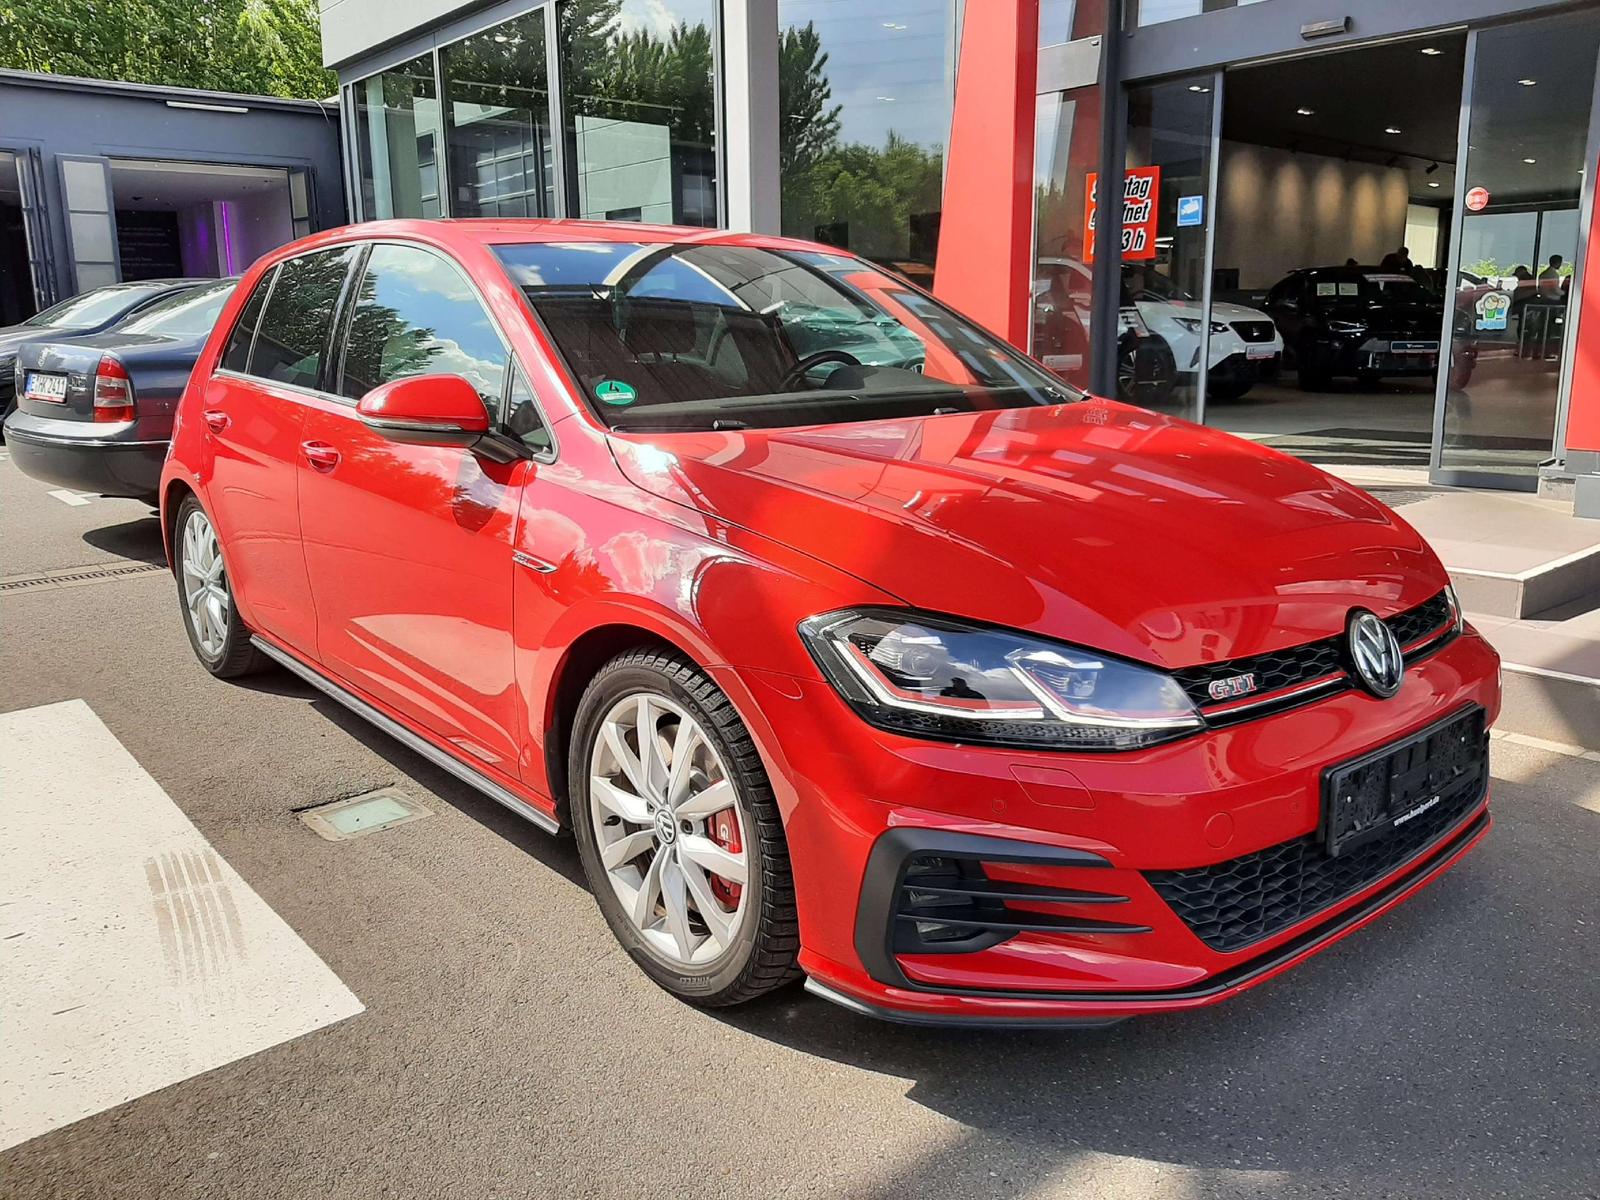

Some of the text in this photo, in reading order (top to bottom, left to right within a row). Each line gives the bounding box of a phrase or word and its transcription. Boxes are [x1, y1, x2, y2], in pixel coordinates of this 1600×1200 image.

[1132, 227, 1146, 251] h
[608, 381, 620, 393] 4
[1208, 673, 1257, 700] GTI
